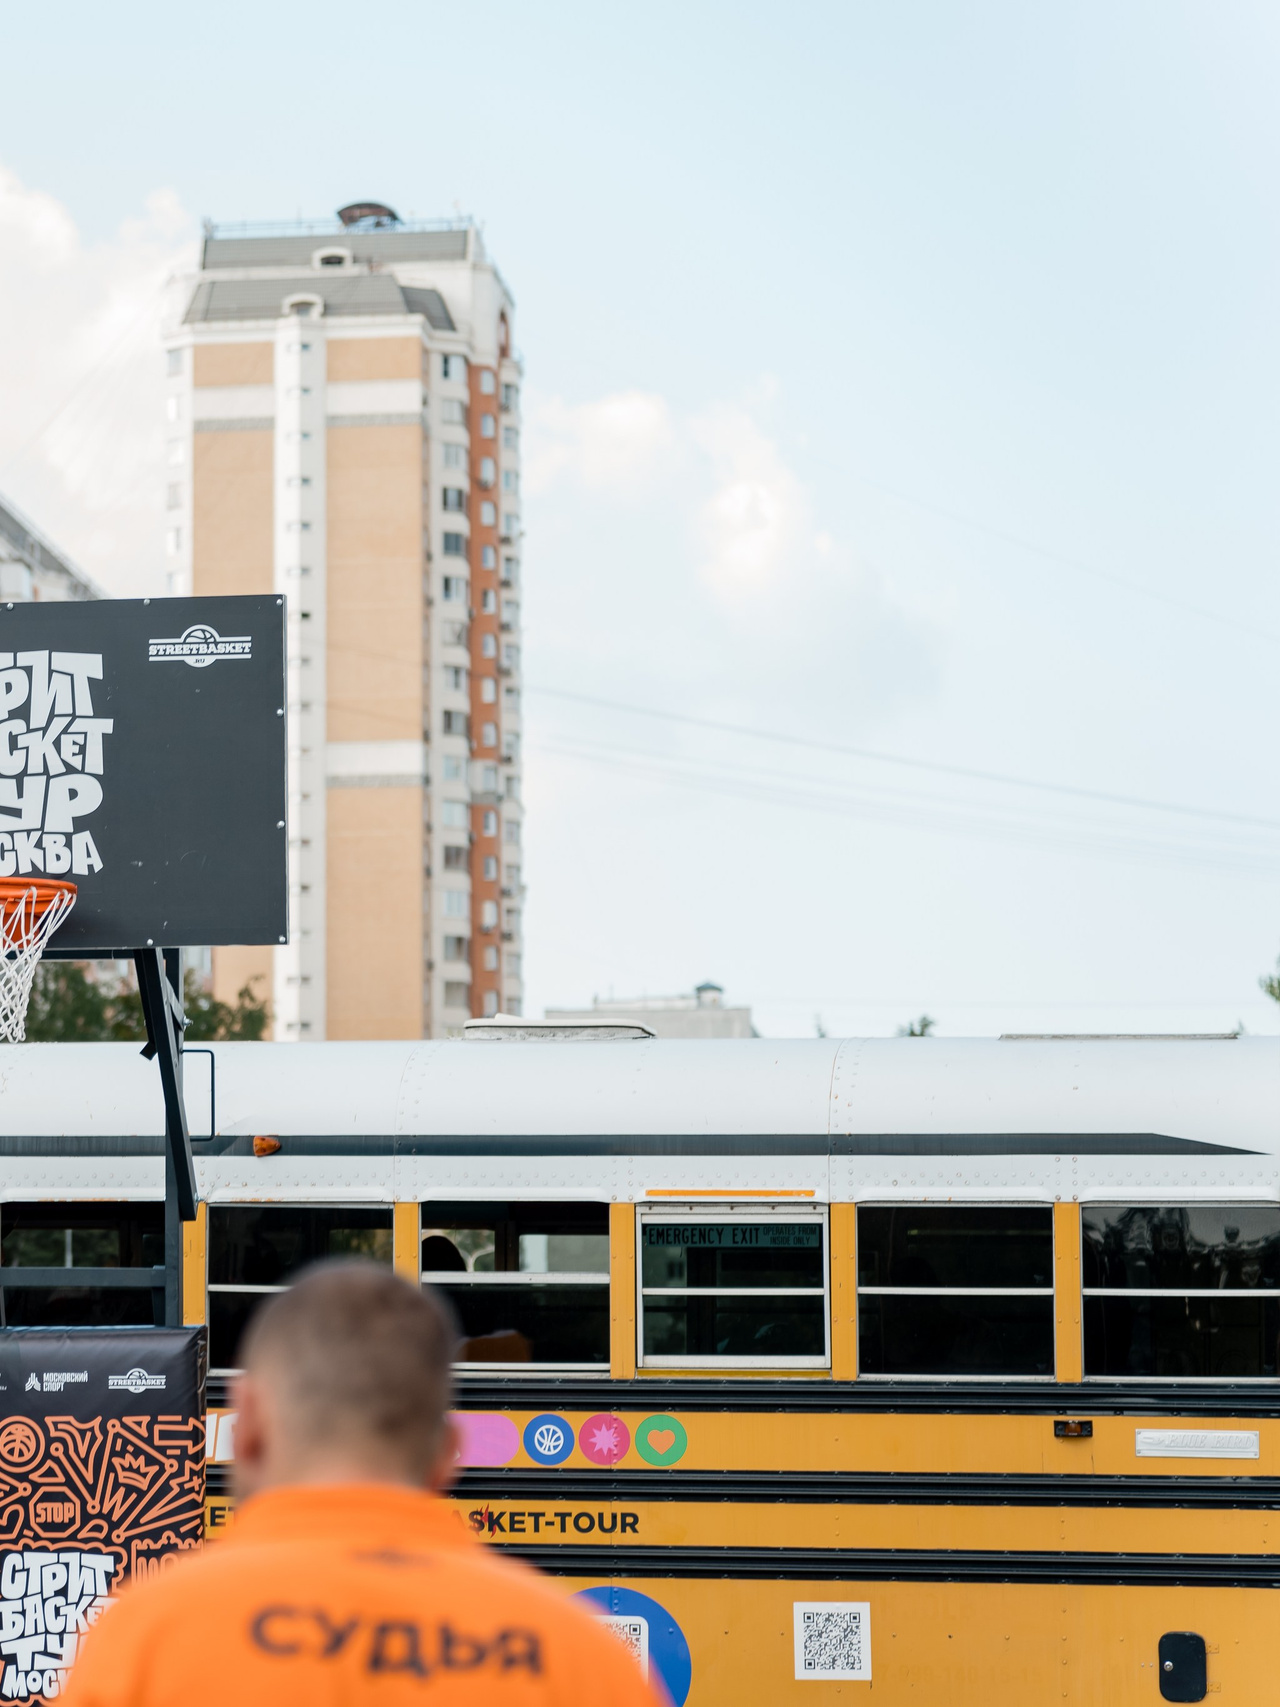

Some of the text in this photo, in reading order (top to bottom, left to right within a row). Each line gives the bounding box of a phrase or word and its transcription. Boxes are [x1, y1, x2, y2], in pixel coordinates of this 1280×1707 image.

[148, 642, 252, 656] STREETBASKET
[648, 1227, 761, 1245] EMERGENCY EXIT
[763, 1226, 817, 1236] OPERATES FROM
[770, 1236, 810, 1246] INSIDE ONLY
[43, 1370, 89, 1383] МОСКОВСКИЙ
[108, 1378, 167, 1386] STREETBASKET
[43, 1382, 65, 1392] СПОРТ
[1165, 1434, 1255, 1450] BLUE BIRD
[36, 1502, 75, 1523] STOP
[1, 1552, 115, 1604] СТРИТ
[250, 1603, 546, 1681] СУДЬЯ
[0, 1633, 90, 1672] ТУ
